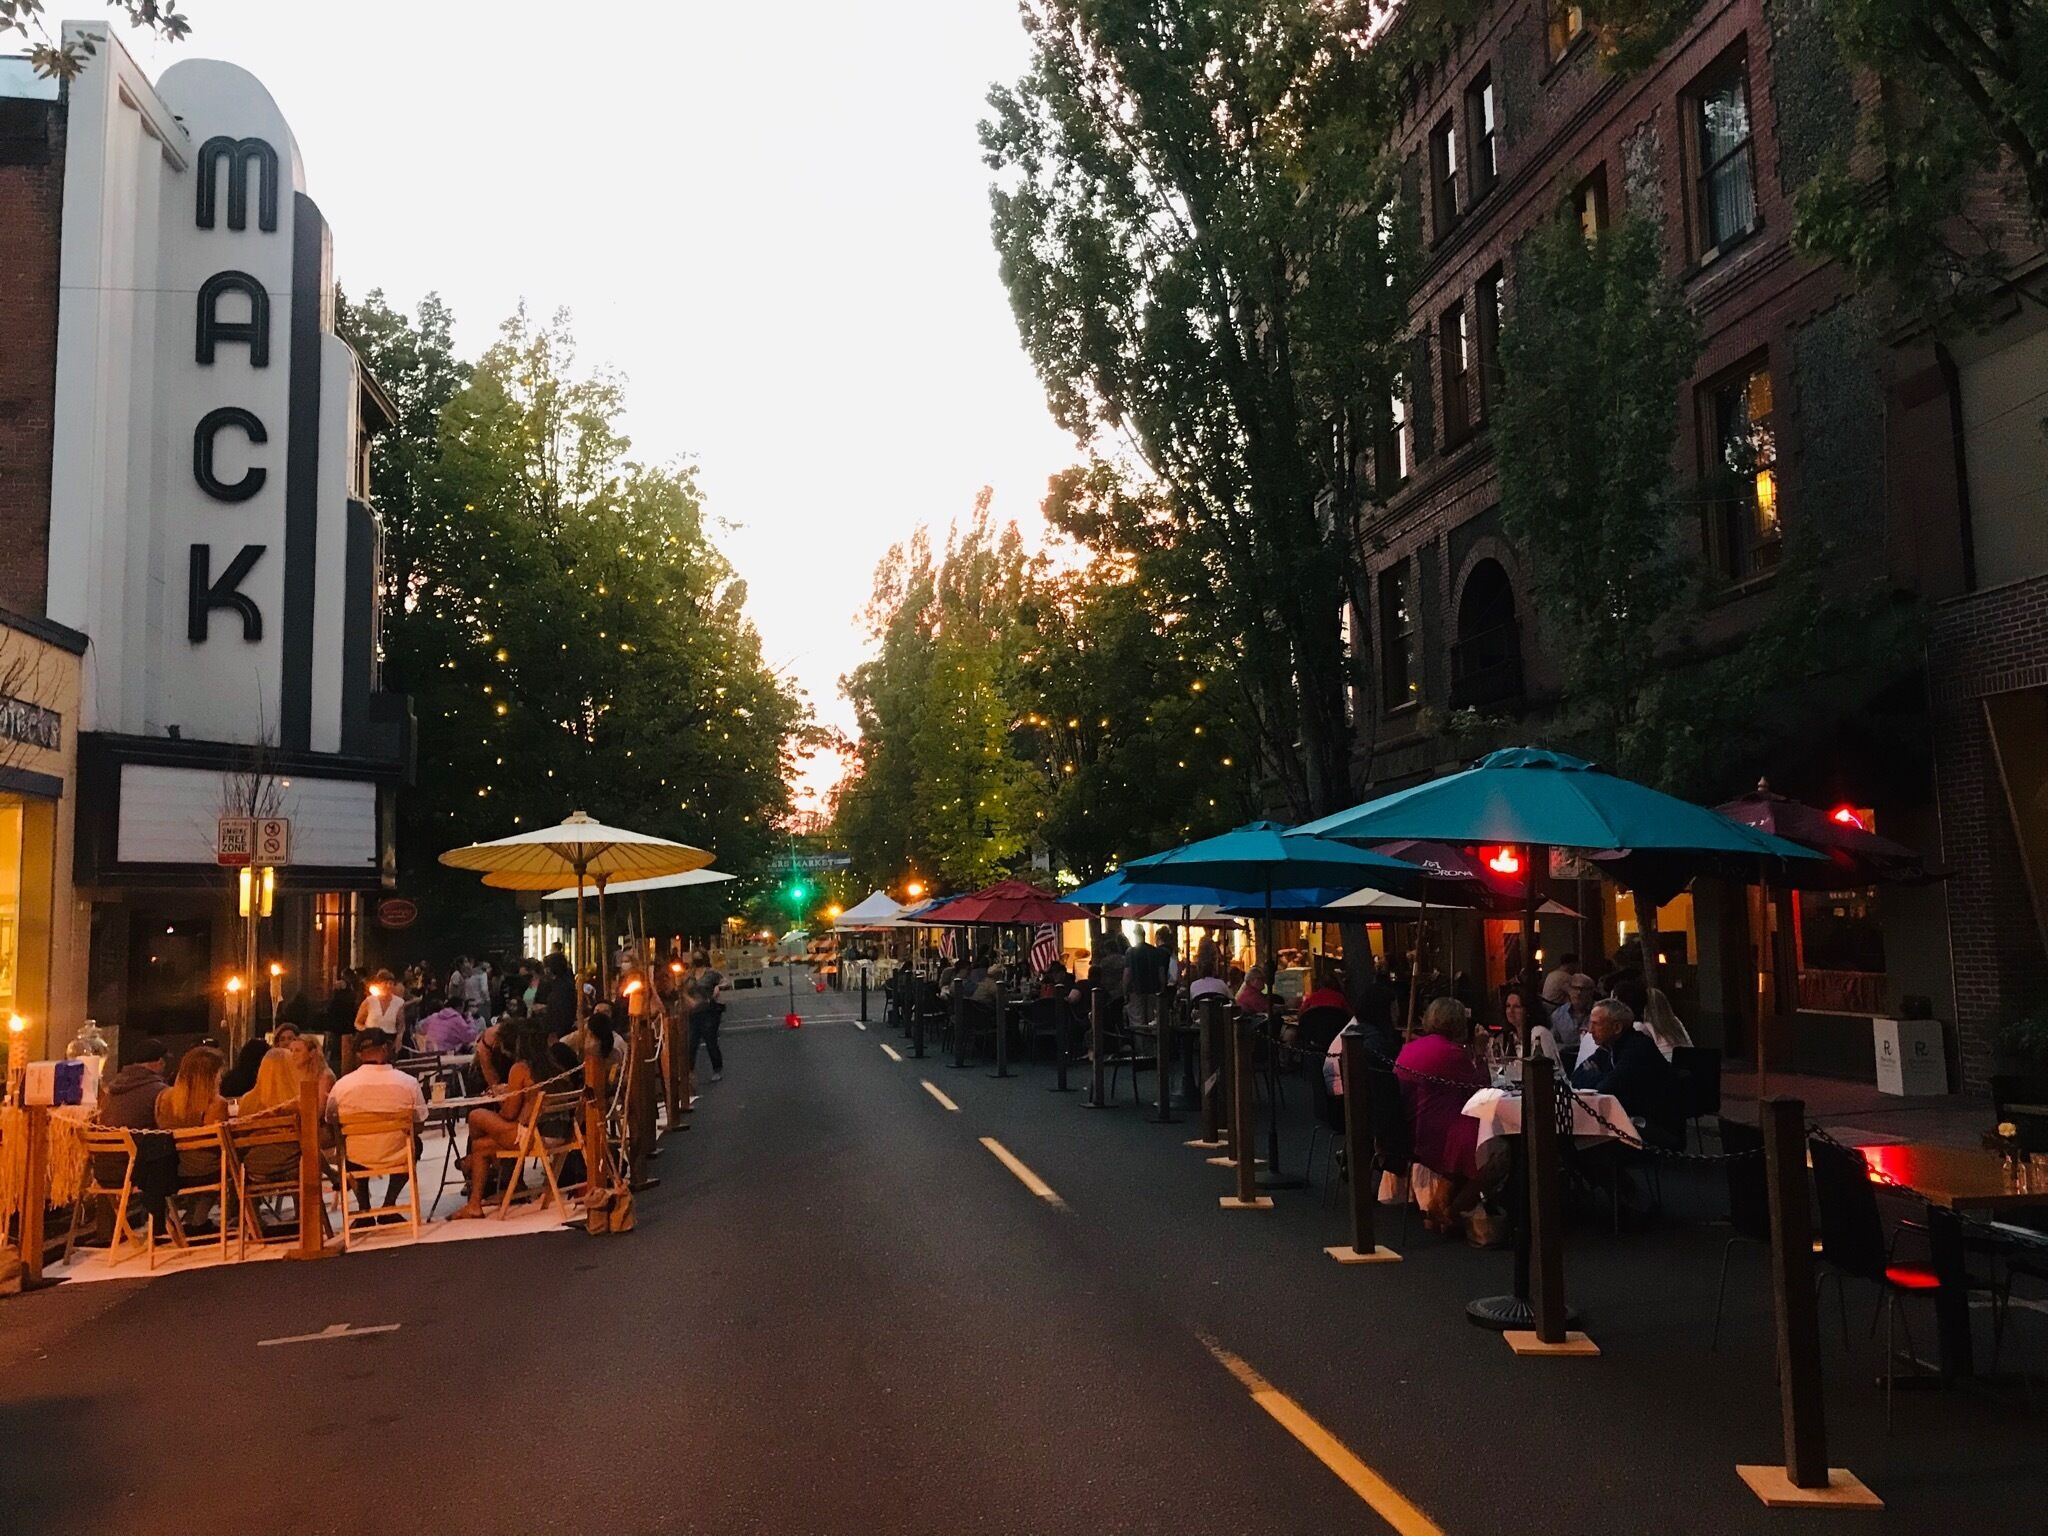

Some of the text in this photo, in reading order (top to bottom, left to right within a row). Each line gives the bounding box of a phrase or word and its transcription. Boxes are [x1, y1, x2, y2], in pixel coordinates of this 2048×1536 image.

[188, 136, 279, 643] MACK
[222, 835, 247, 843] FREE
[221, 844, 247, 852] ZONE
[793, 858, 834, 868] MARKET
[1428, 868, 1474, 877] ORONA
